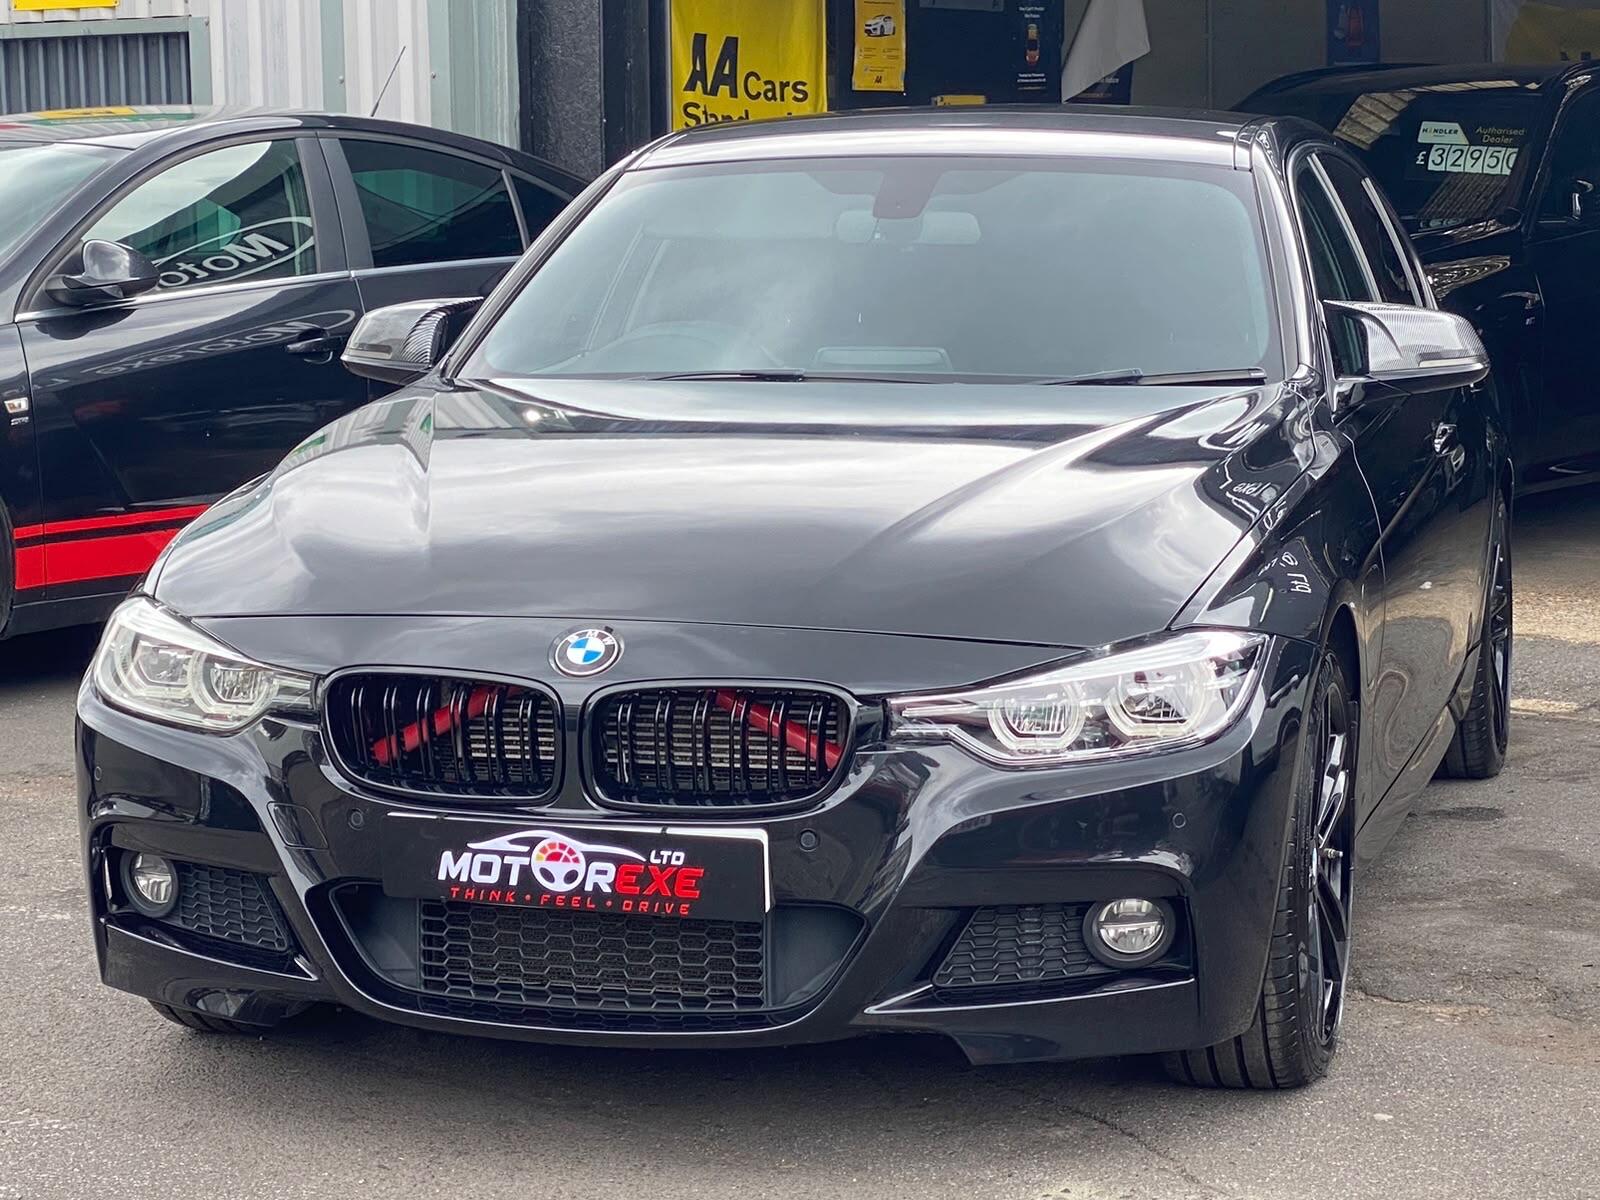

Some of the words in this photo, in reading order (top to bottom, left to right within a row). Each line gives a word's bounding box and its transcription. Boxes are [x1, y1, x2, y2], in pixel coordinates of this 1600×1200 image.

[683, 33, 739, 98] AA
[743, 71, 809, 102] Cars
[1482, 134, 1513, 144] Dealer
[650, 850, 685, 865] LTD
[450, 887, 516, 903] THINK
[540, 894, 596, 908] FEEL
[622, 900, 691, 915] DRIVE
